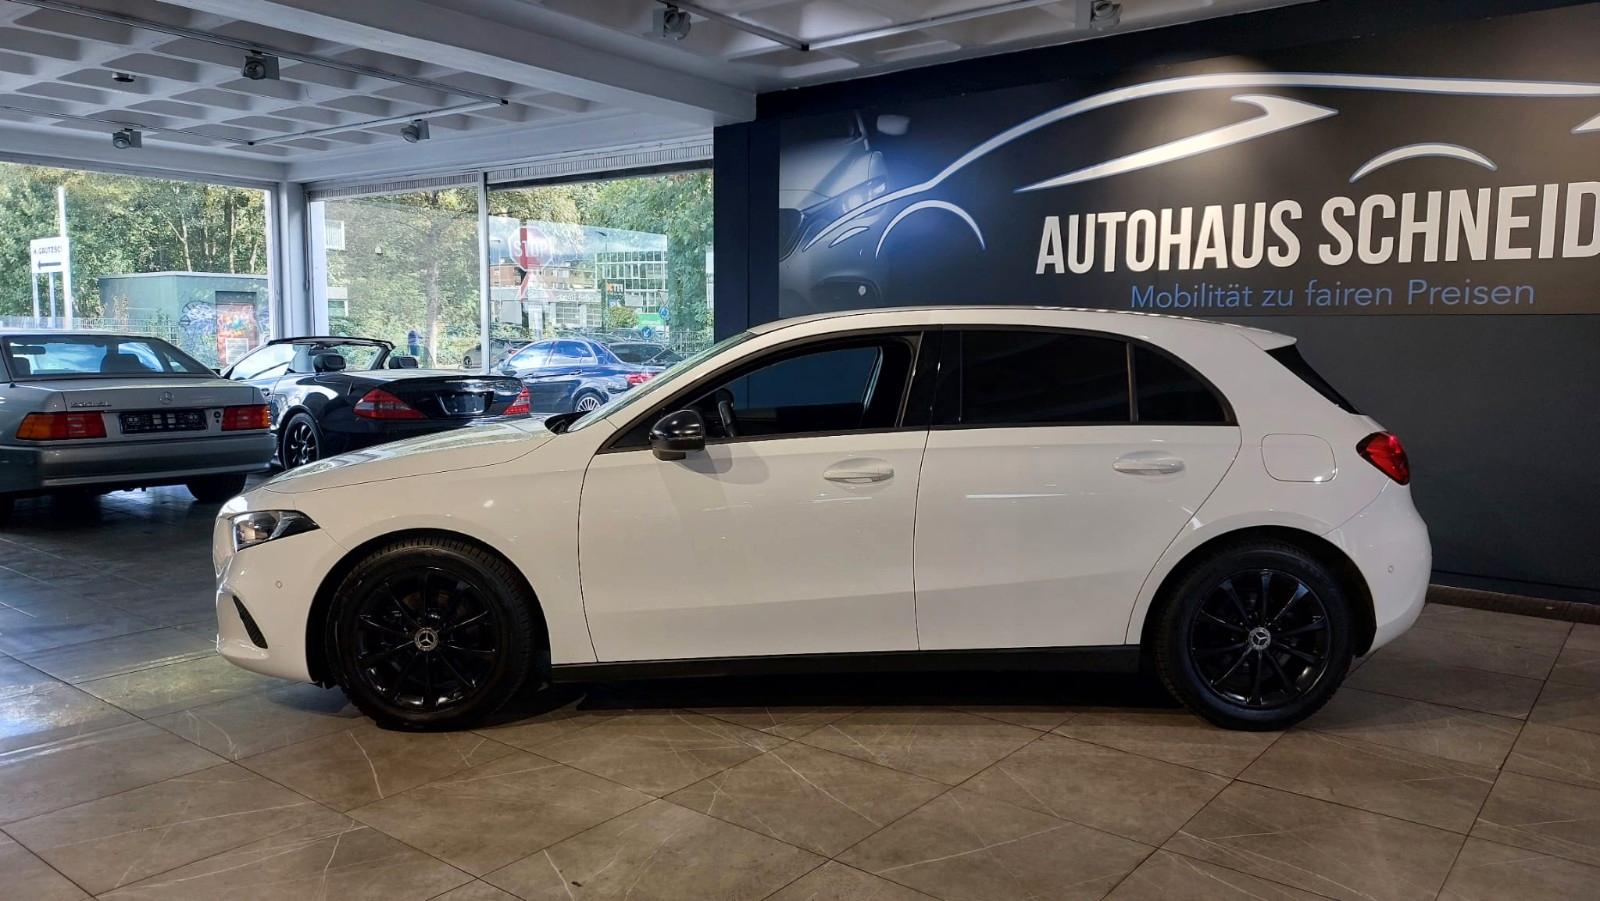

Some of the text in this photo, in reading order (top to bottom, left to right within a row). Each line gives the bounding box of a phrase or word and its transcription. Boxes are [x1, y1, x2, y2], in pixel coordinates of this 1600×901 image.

[1035, 181, 1600, 275] AUTOHAUS SCHNEID
[514, 240, 548, 257] STOP
[1131, 278, 1535, 308] Mobilität zu fairen Preisen
